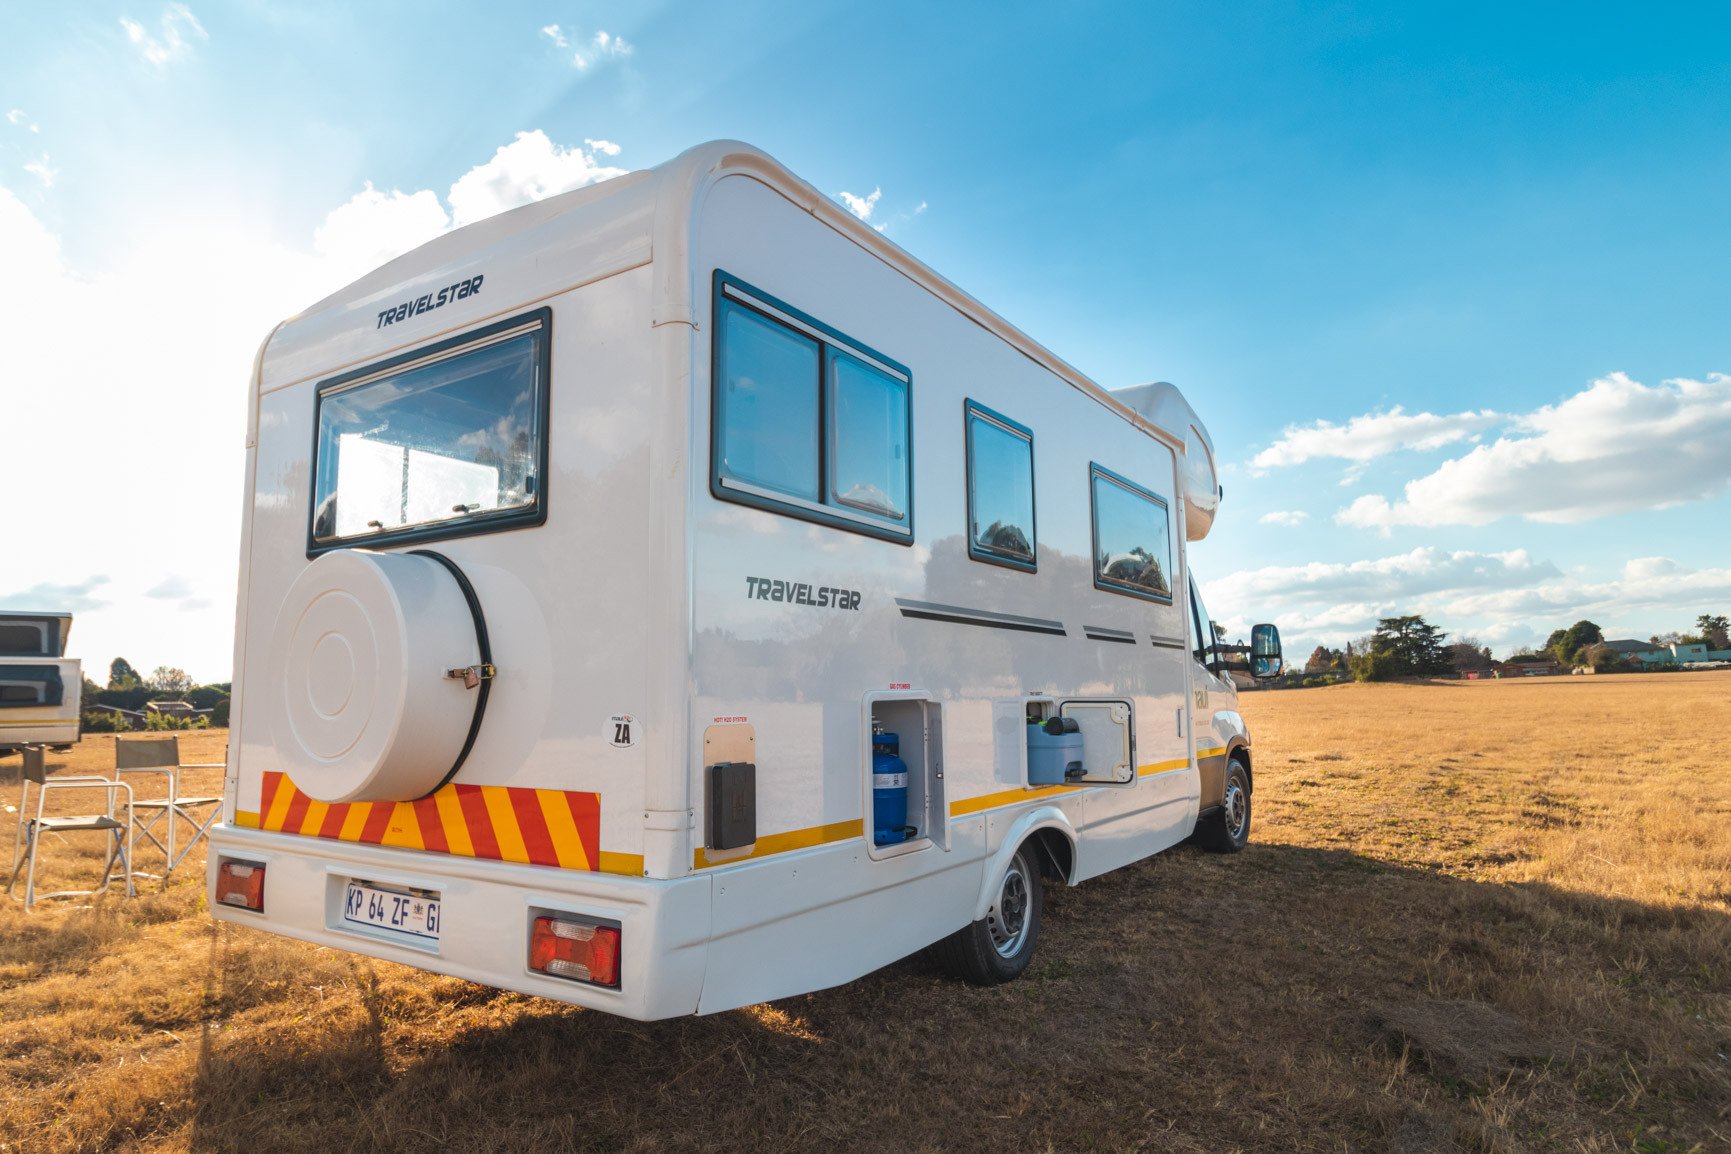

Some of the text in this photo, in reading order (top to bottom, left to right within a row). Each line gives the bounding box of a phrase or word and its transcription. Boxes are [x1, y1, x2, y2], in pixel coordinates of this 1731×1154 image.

[614, 723, 631, 744] ZA
[347, 888, 440, 933] KP 64 ZF G
